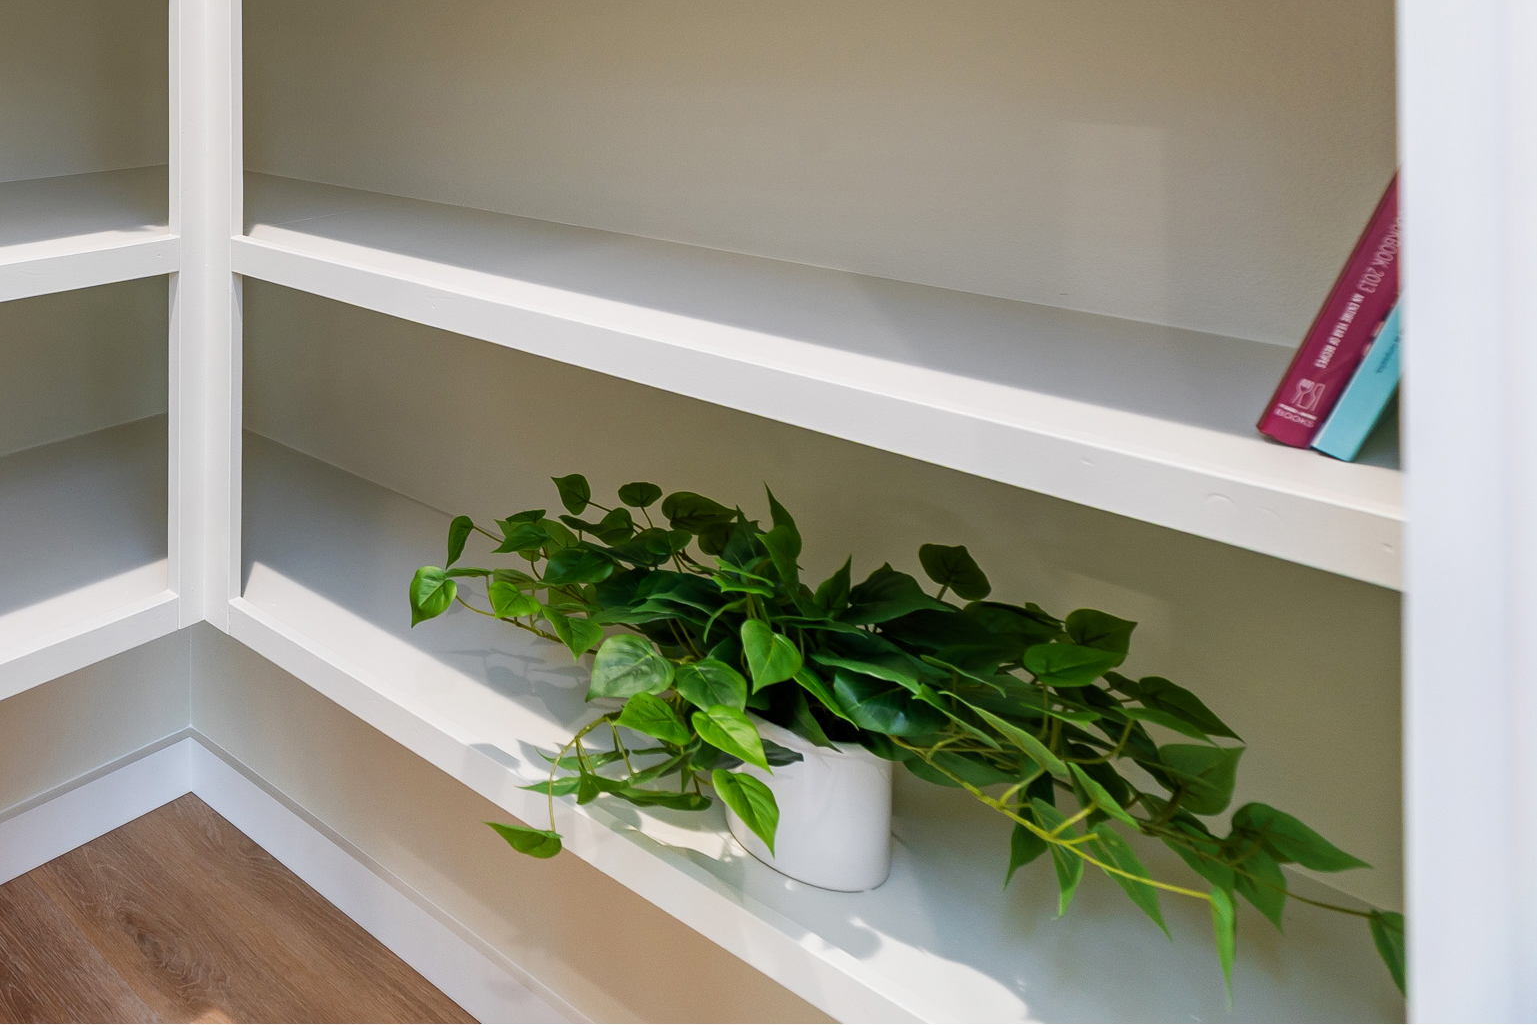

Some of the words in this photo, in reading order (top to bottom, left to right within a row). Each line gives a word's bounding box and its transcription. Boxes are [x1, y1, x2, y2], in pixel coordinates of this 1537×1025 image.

[1356, 267, 1385, 293] 2013
[1332, 322, 1350, 339] YEAR
[1314, 344, 1337, 368] RECIPES
[1274, 408, 1315, 428] BOOKS
